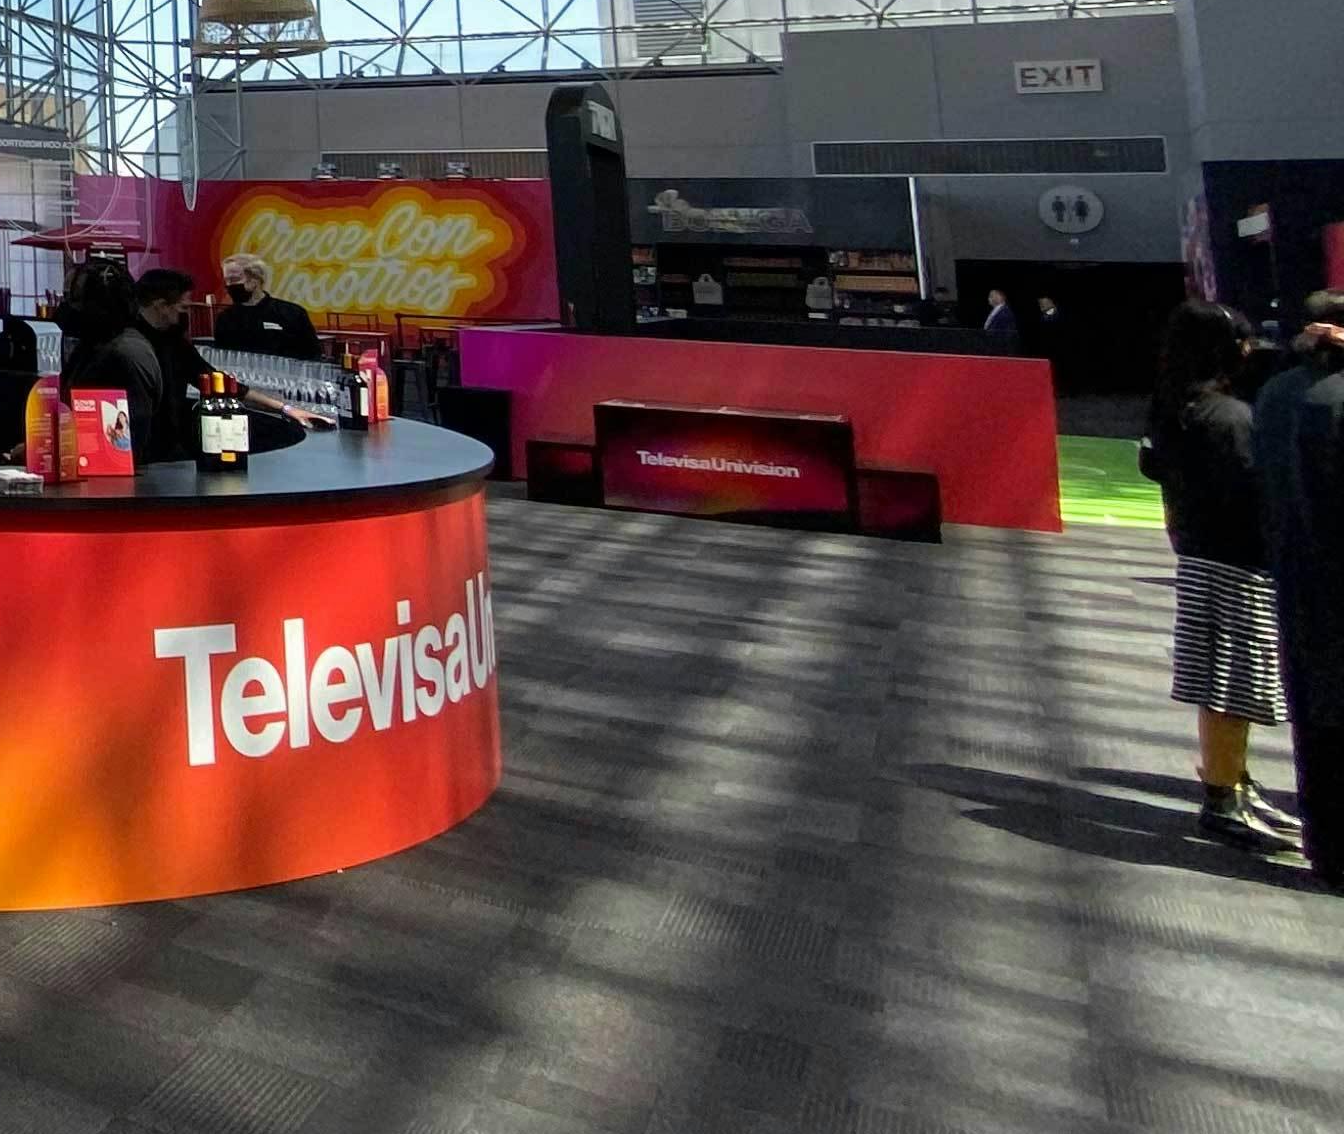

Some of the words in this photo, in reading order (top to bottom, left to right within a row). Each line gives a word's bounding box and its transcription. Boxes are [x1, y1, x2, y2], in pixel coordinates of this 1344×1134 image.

[1020, 65, 1096, 88] EXIT
[239, 210, 375, 262] Crece
[377, 201, 493, 258] Con
[636, 449, 800, 478] TelevisaUnivision
